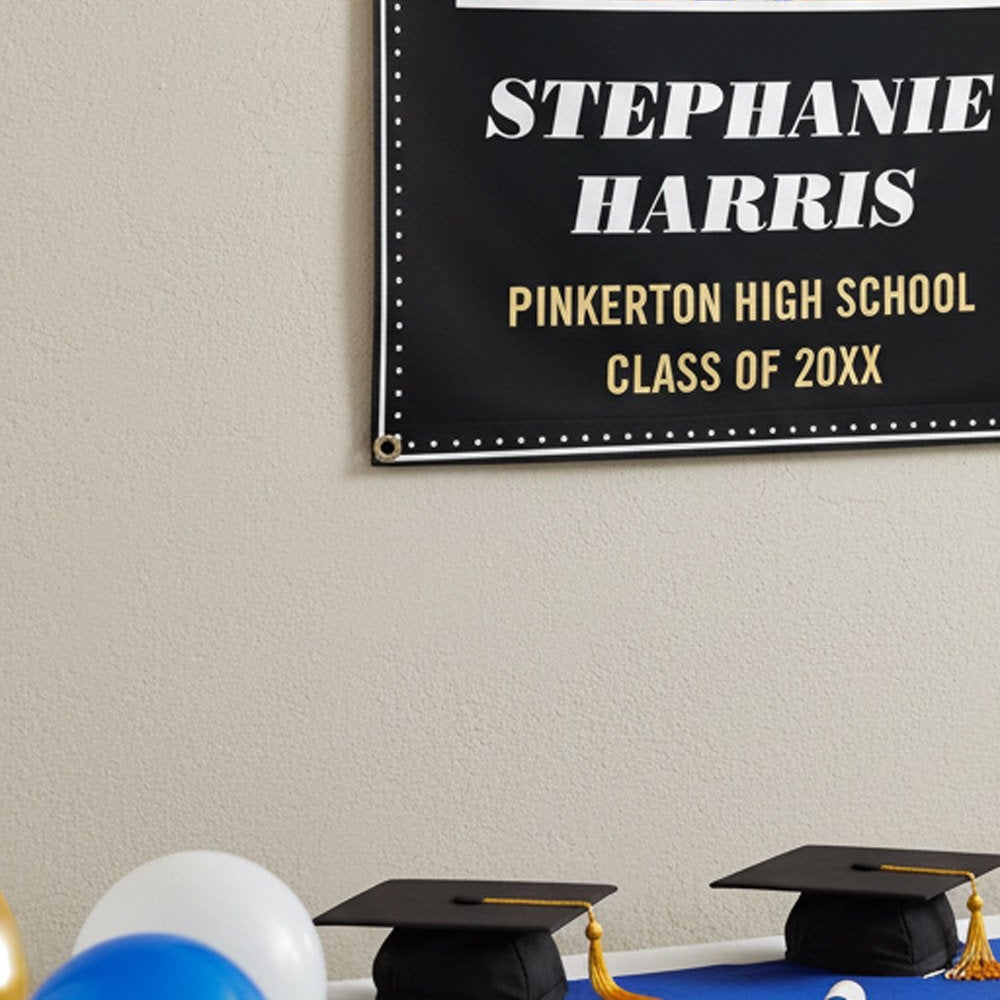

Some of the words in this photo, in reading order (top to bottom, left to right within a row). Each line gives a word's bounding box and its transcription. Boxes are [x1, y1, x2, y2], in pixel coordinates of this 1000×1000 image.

[485, 73, 995, 141] STEPHANIE
[570, 167, 917, 236] HARRIS
[509, 282, 722, 328] PINKERTON
[735, 279, 823, 322] HIGH
[836, 271, 976, 318] SCHOOL
[606, 351, 721, 395] CLASS
[735, 349, 781, 391] OF
[794, 343, 883, 388] 20XX
